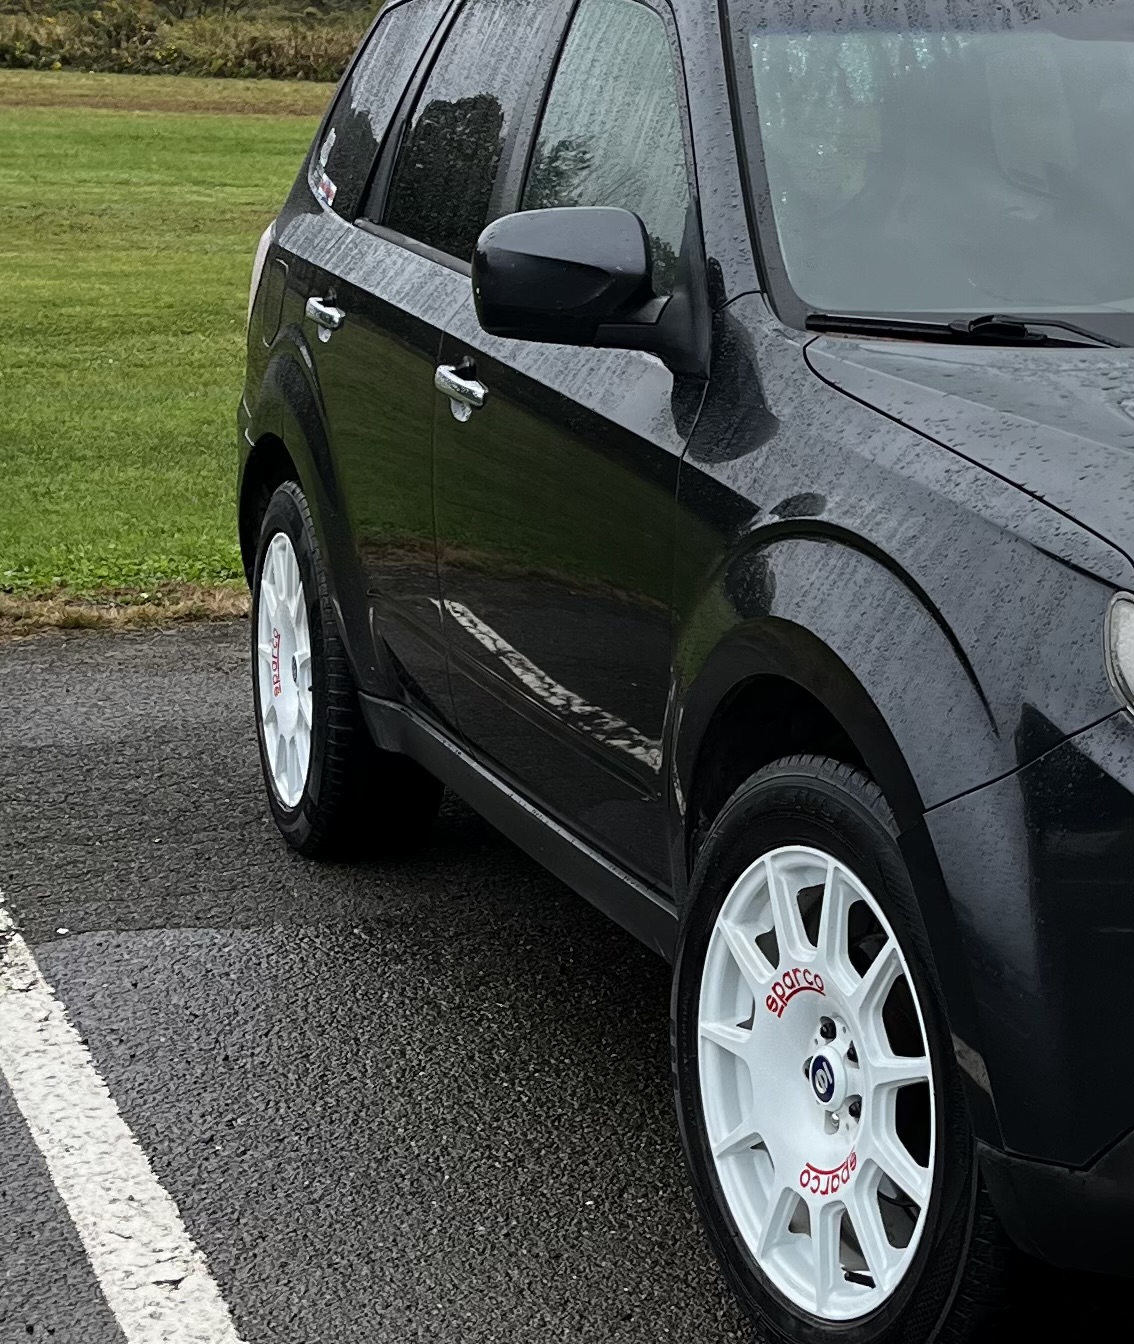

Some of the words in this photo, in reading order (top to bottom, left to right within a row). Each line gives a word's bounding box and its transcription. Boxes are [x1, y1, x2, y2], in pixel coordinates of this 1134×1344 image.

[272, 627, 281, 697] sparco
[766, 967, 825, 1017] sparco
[799, 1151, 857, 1195] sparco
